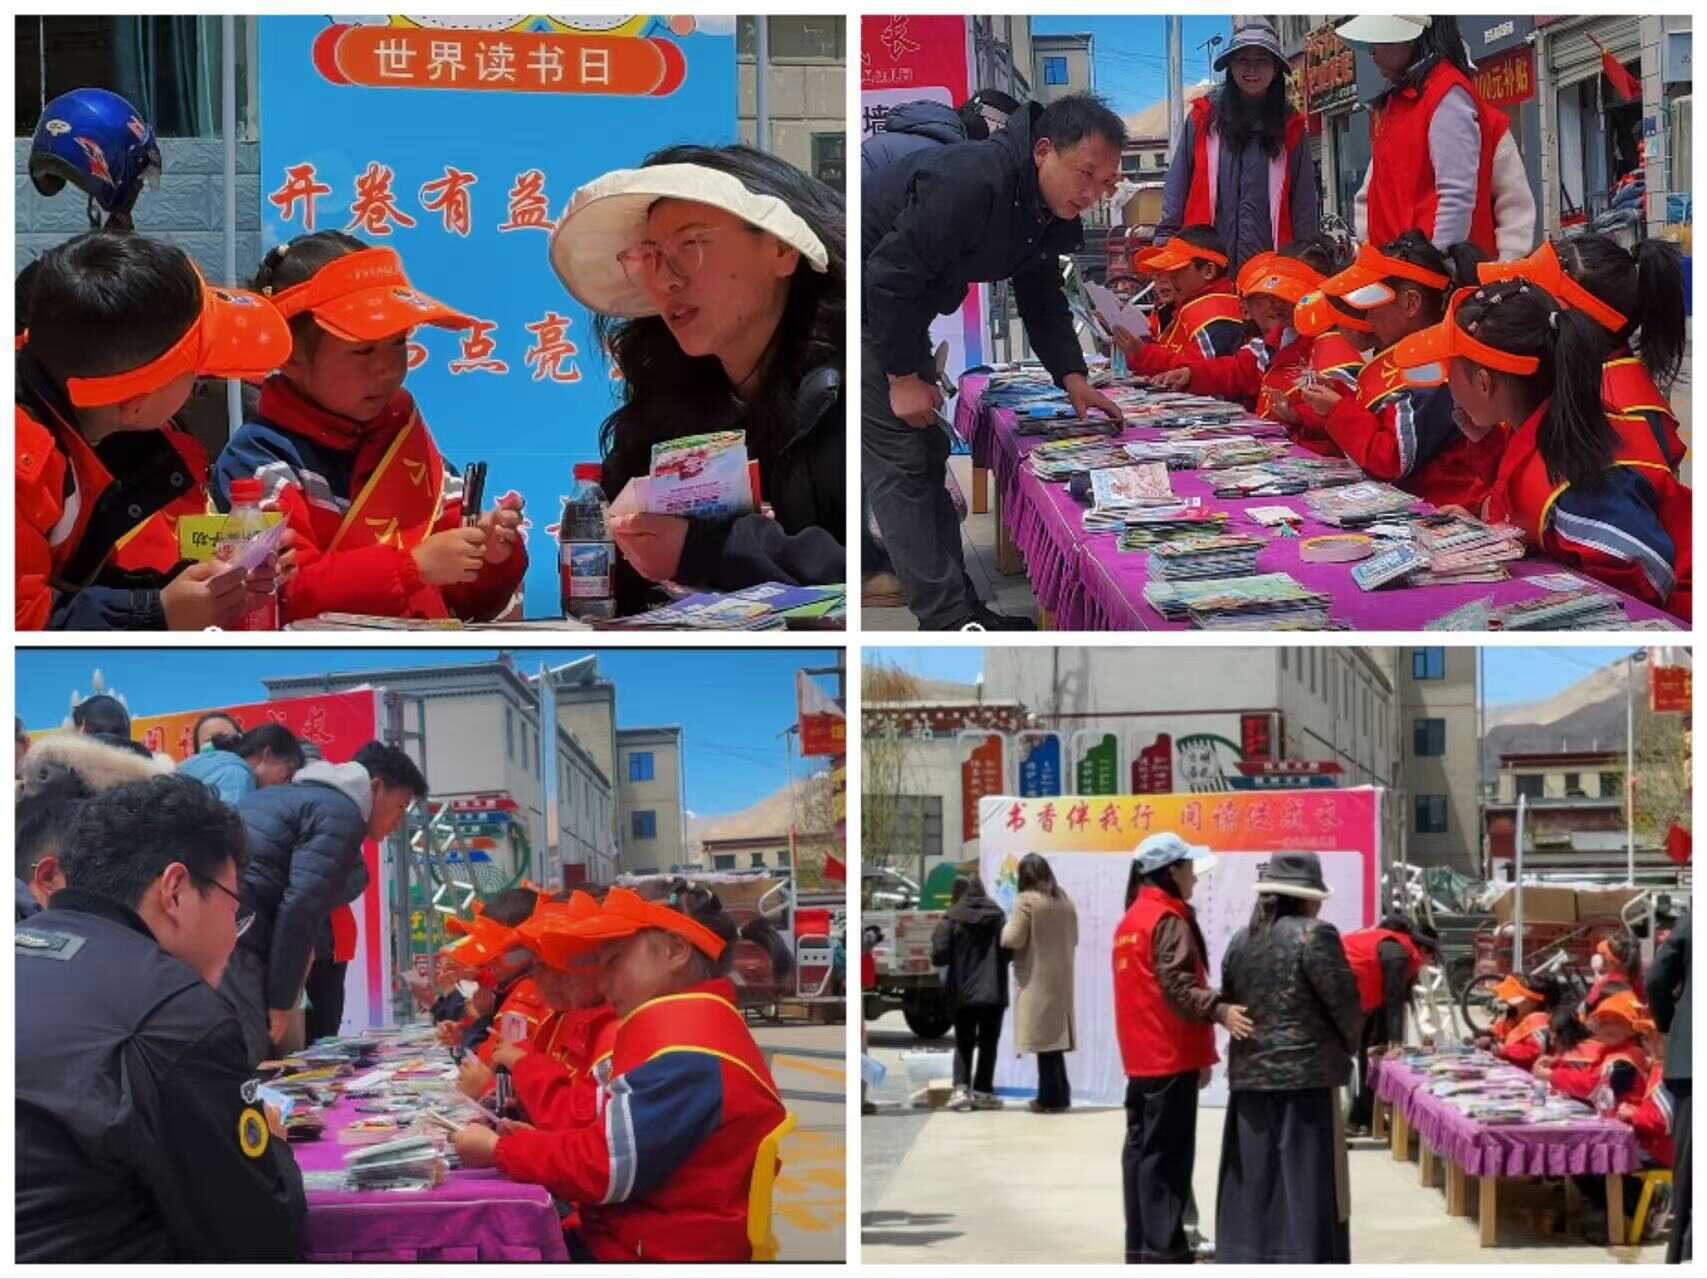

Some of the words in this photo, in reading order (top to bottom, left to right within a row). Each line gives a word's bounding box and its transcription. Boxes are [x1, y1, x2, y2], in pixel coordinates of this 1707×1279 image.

[373, 38, 611, 85] 世界读书日
[268, 160, 560, 236] 开卷有益
[405, 310, 583, 382] 点亮
[1005, 800, 1155, 833] 书香伴我行
